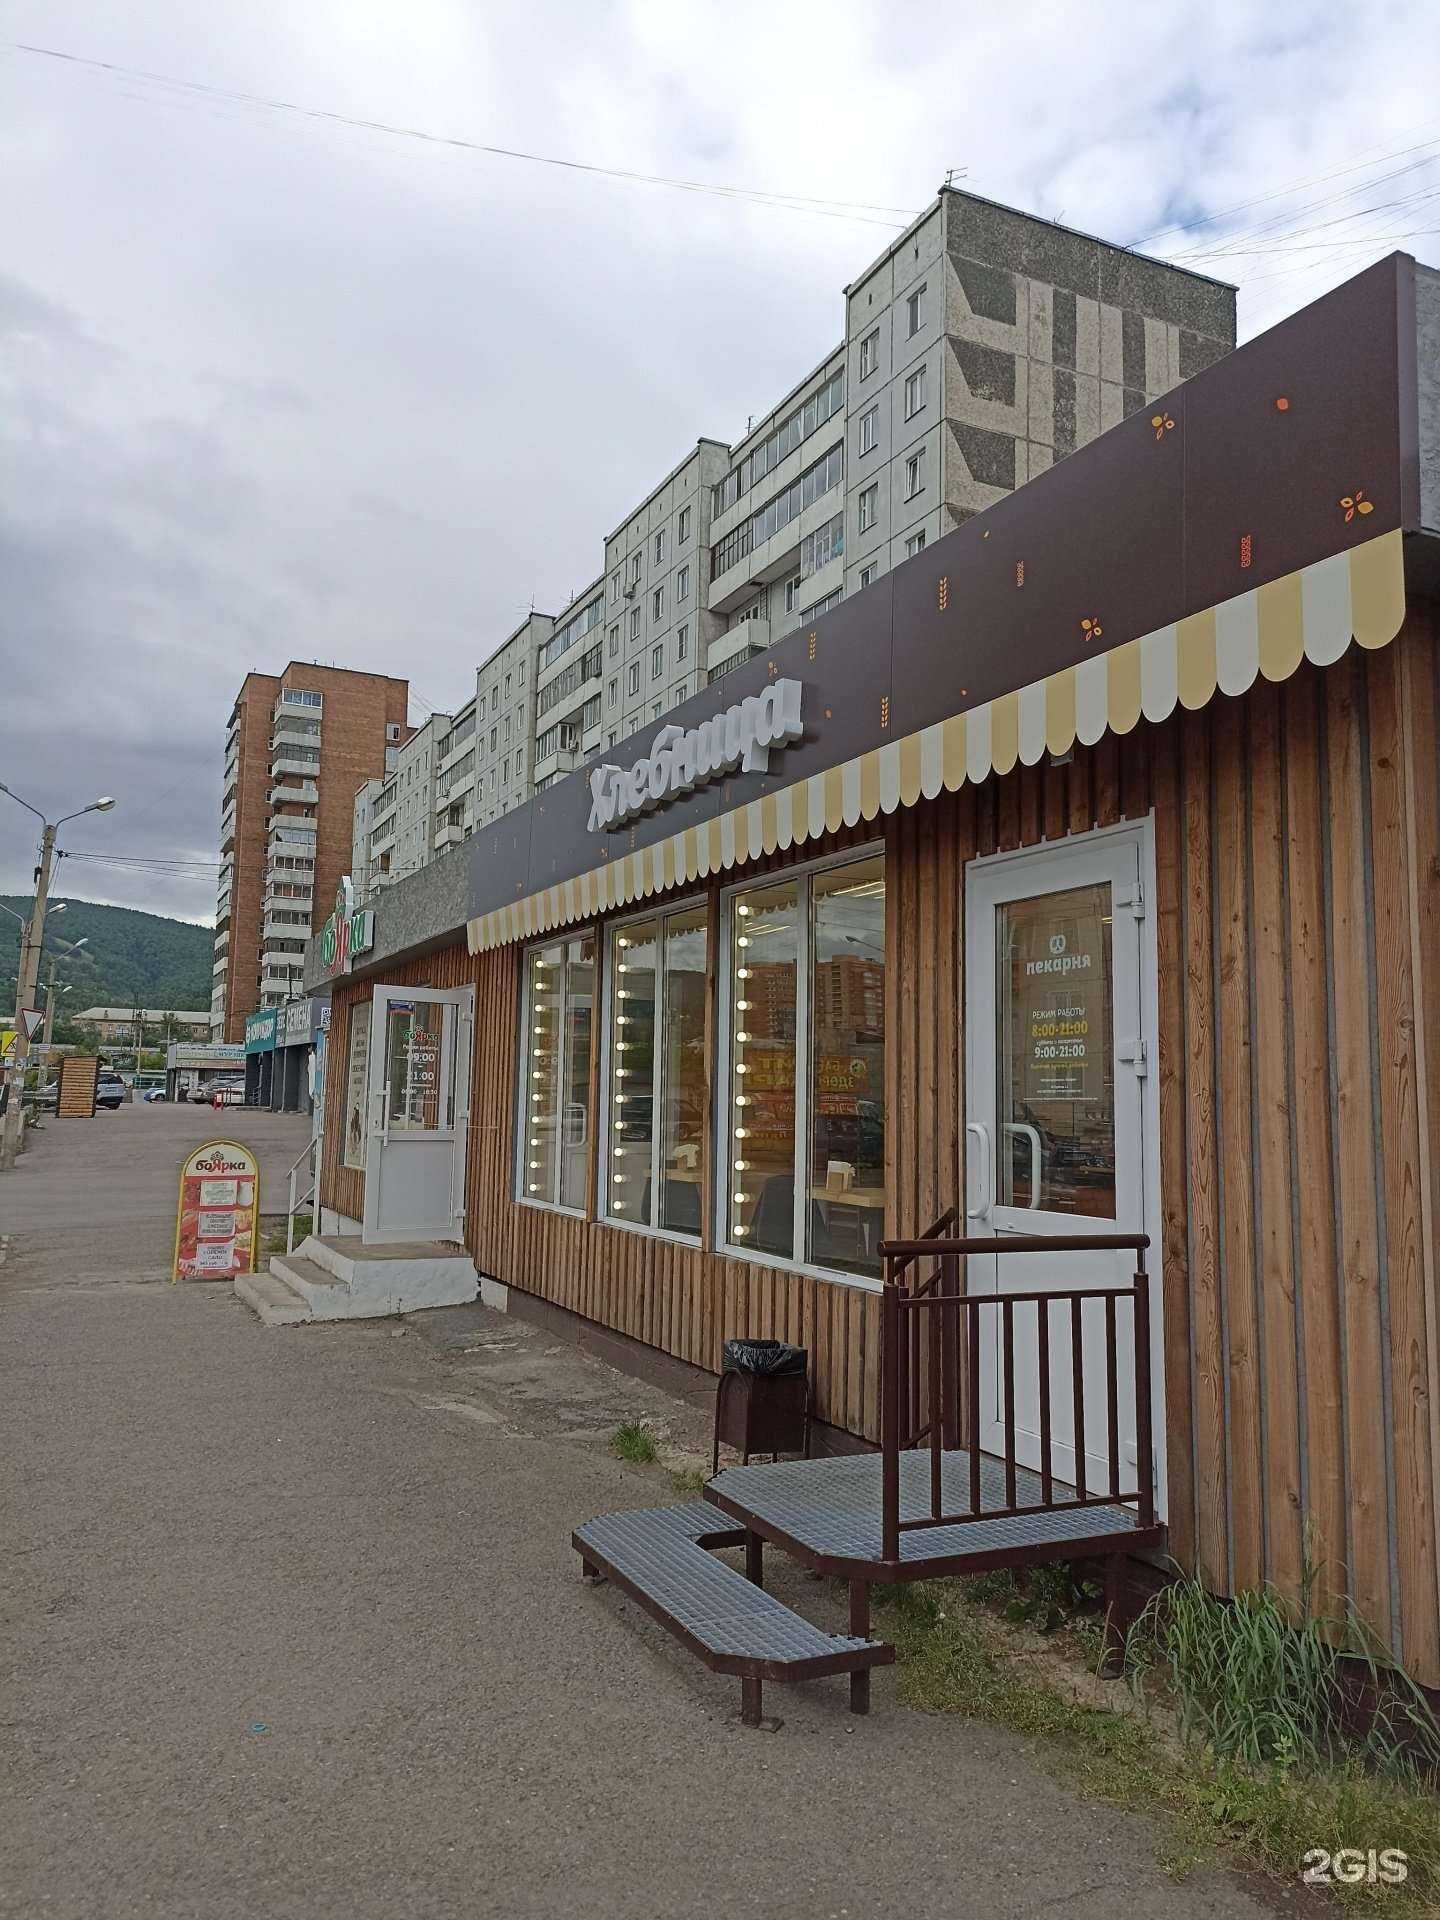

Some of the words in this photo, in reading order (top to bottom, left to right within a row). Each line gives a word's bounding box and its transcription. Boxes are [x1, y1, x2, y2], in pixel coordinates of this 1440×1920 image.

[587, 679, 803, 832] Хлебница
[1026, 955, 1091, 976] пекарня
[1032, 1009, 1056, 1019] РЕЖИМ
[1057, 1007, 1086, 1017] РАБОТЫ
